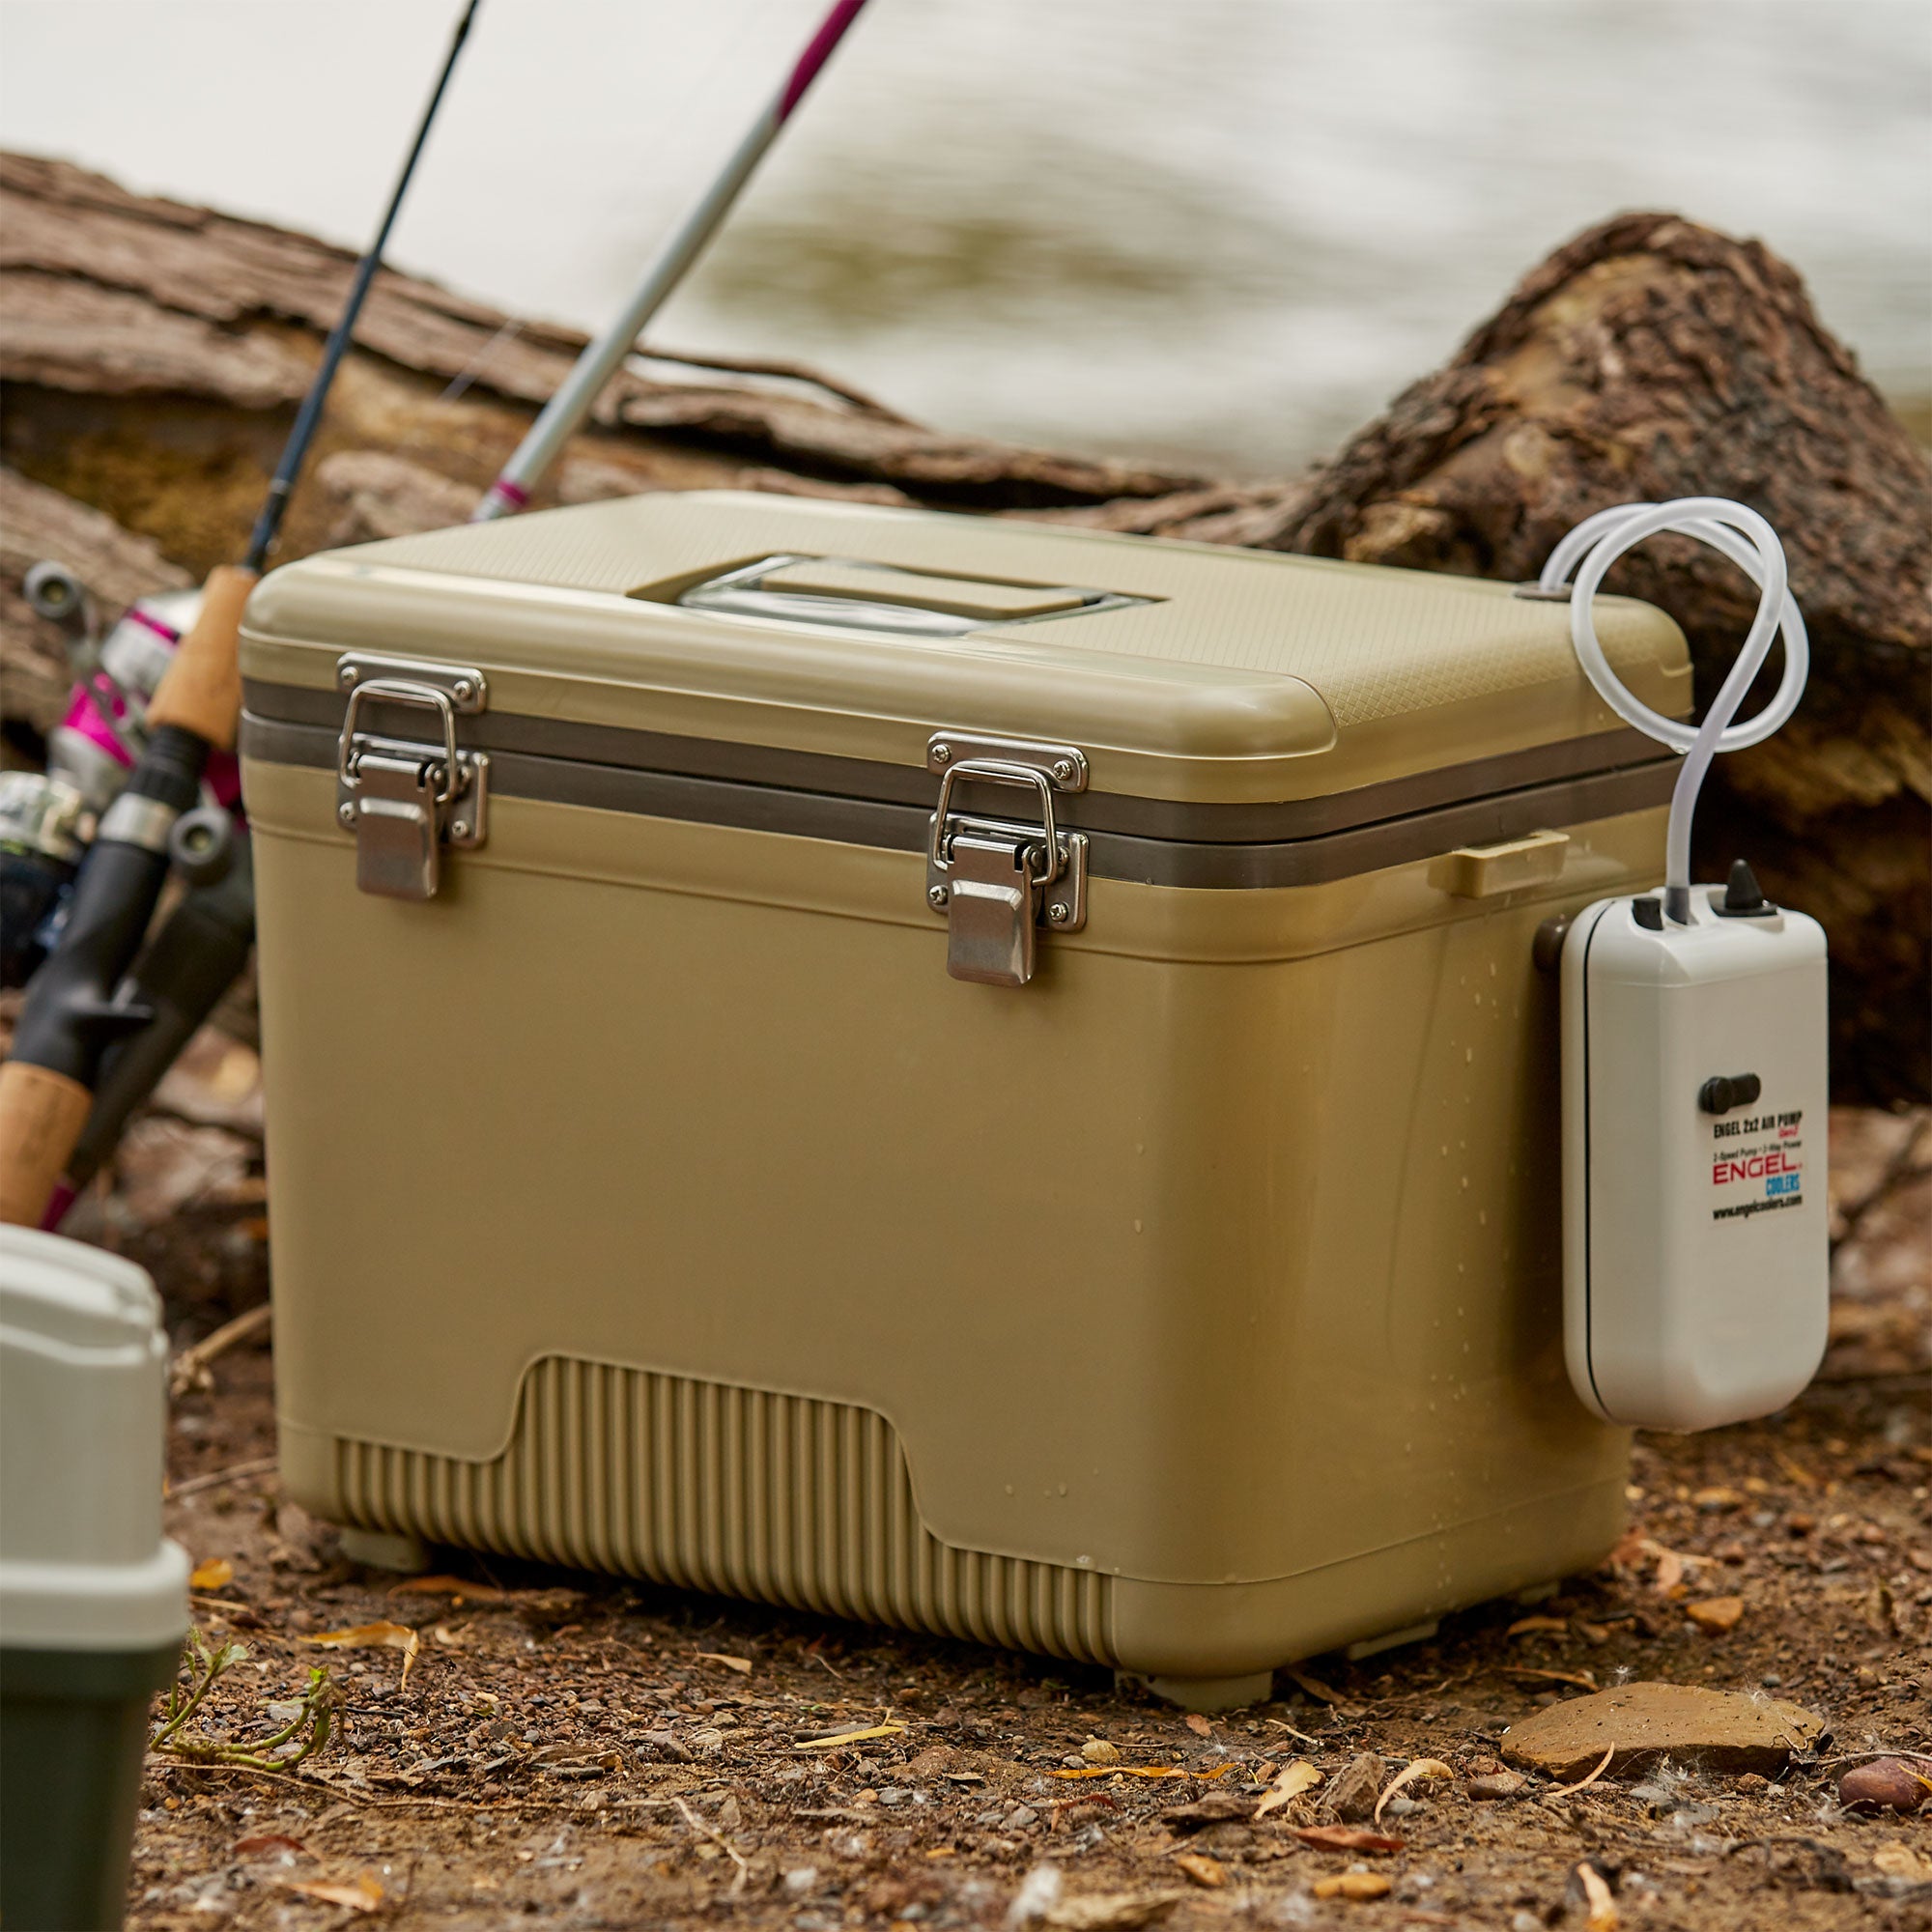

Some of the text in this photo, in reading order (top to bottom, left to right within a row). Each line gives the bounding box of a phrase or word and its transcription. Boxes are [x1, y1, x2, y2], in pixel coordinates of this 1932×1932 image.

[1714, 1110, 1803, 1139] ENGEL 2x2 AIR PUMP
[1713, 1151, 1797, 1185] ENGEL
[1766, 1173, 1801, 1197] COOLERS
